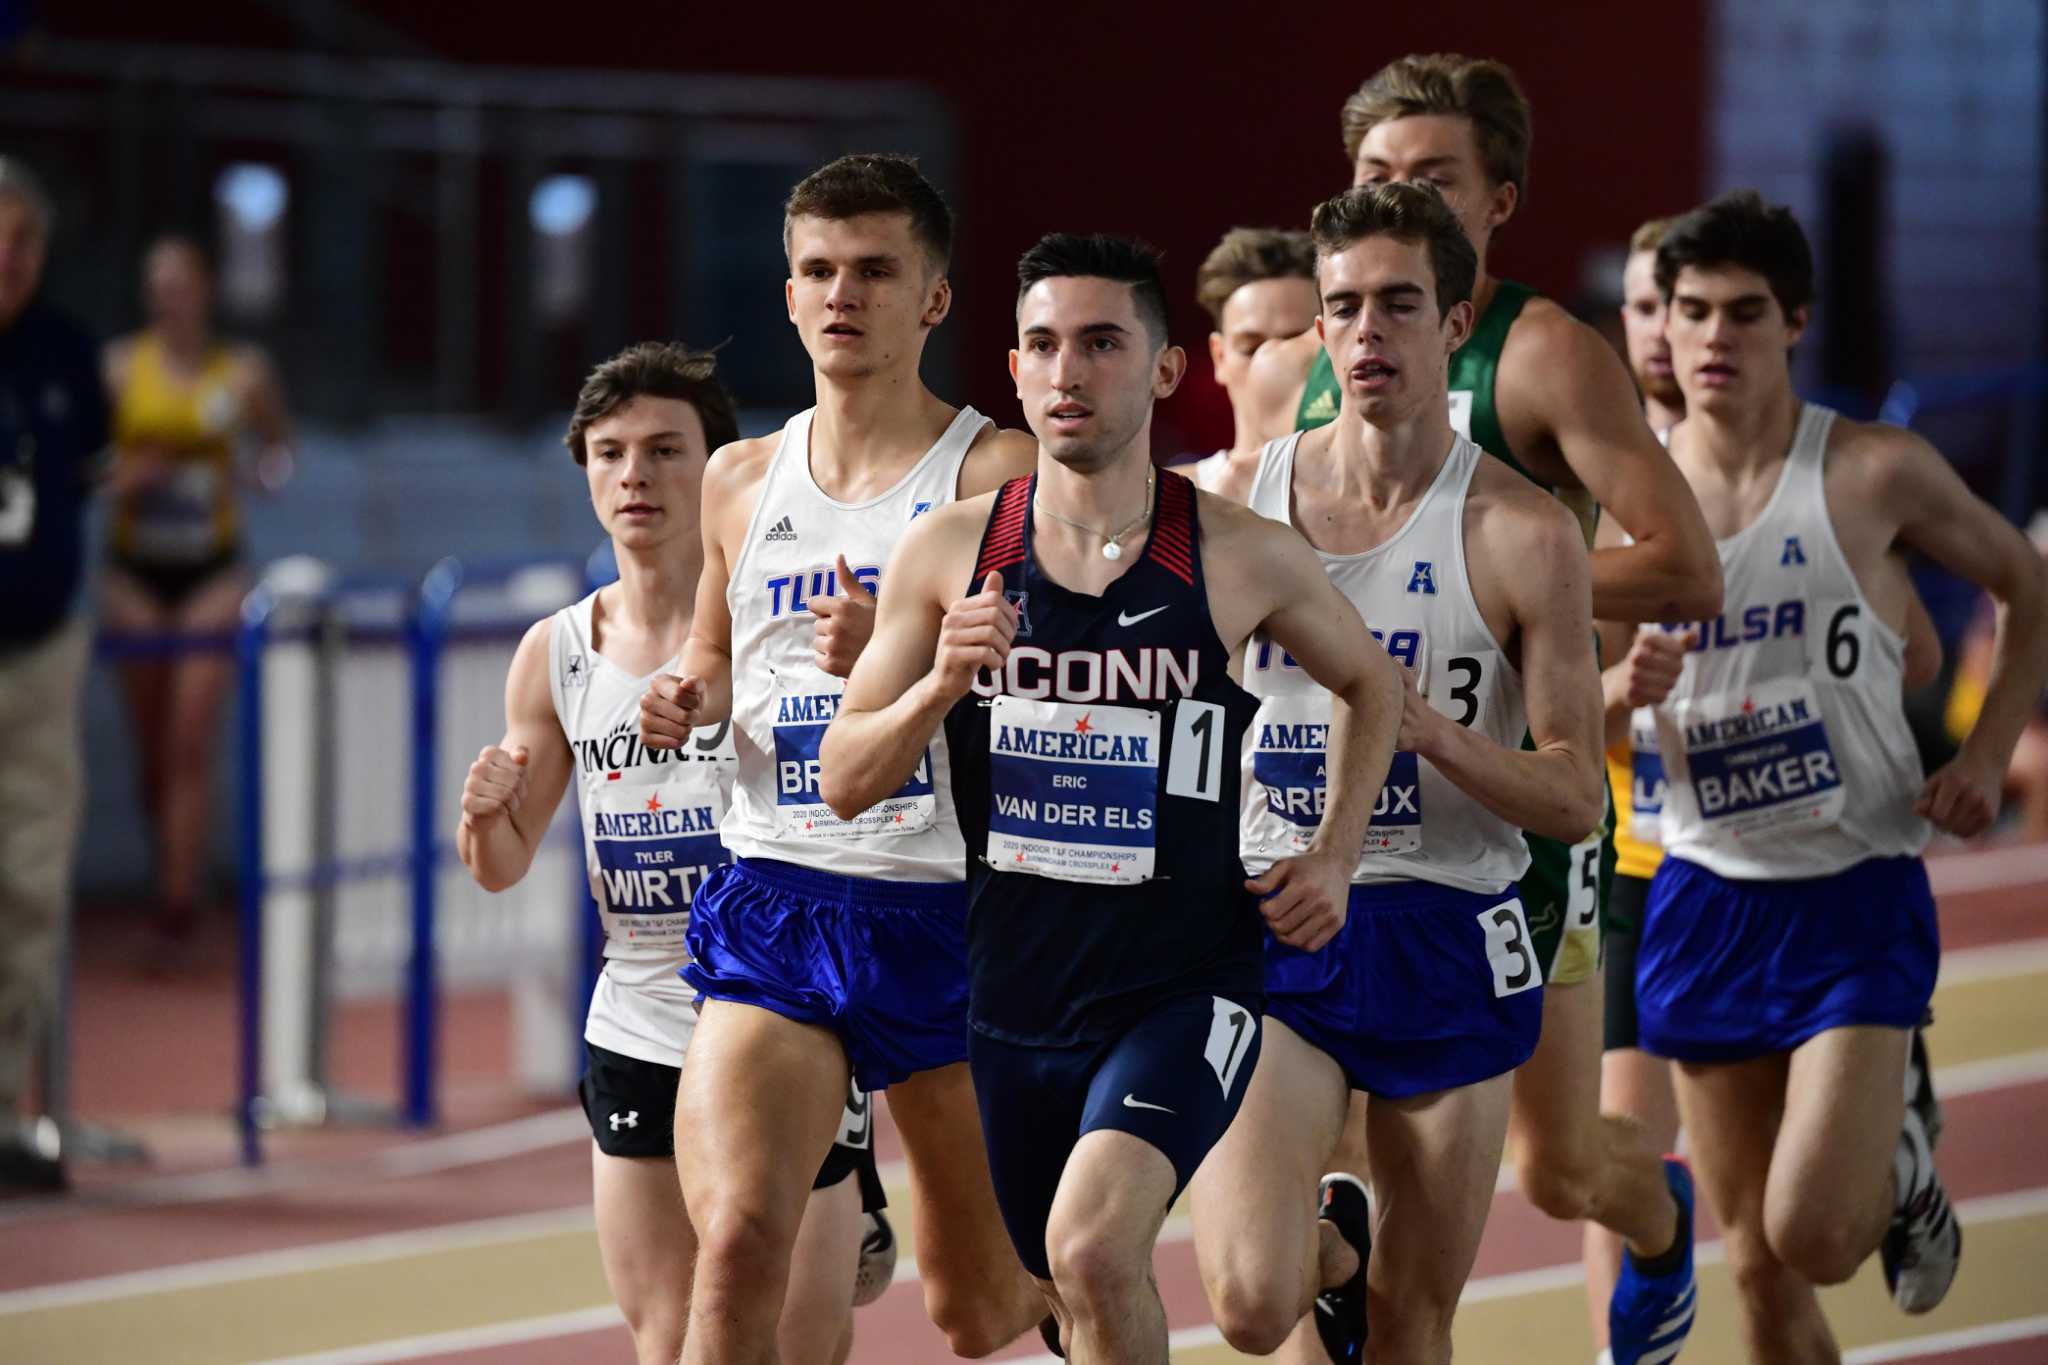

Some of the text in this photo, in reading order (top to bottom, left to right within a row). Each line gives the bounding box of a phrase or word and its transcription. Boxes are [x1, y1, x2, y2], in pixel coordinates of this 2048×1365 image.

[766, 531, 798, 541] adidas
[767, 566, 881, 617] TUS
[1660, 600, 1806, 652] LSA
[1826, 605, 1860, 679] 6
[1448, 657, 1482, 728] 3
[997, 725, 1149, 763] AMERICAN
[1686, 699, 1809, 747] AMERICAN
[573, 734, 736, 772] INCIN
[1191, 710, 1213, 793] 1
[1052, 775, 1087, 789] ERIC
[1266, 785, 1417, 816] BREUX
[1699, 750, 1836, 812] BAKER
[595, 806, 715, 837] AMERICAN
[808, 807, 834, 818] INDOO
[995, 794, 1152, 829] VAN DER ELS
[634, 851, 674, 865] TYLER
[1020, 841, 1050, 853] INDOOR
[1068, 850, 1137, 862] CHAMPIONSHIPS
[602, 863, 728, 908] WIRT
[1579, 848, 1597, 925] 5
[1493, 909, 1531, 989] 3
[1221, 1010, 1247, 1082] 1
